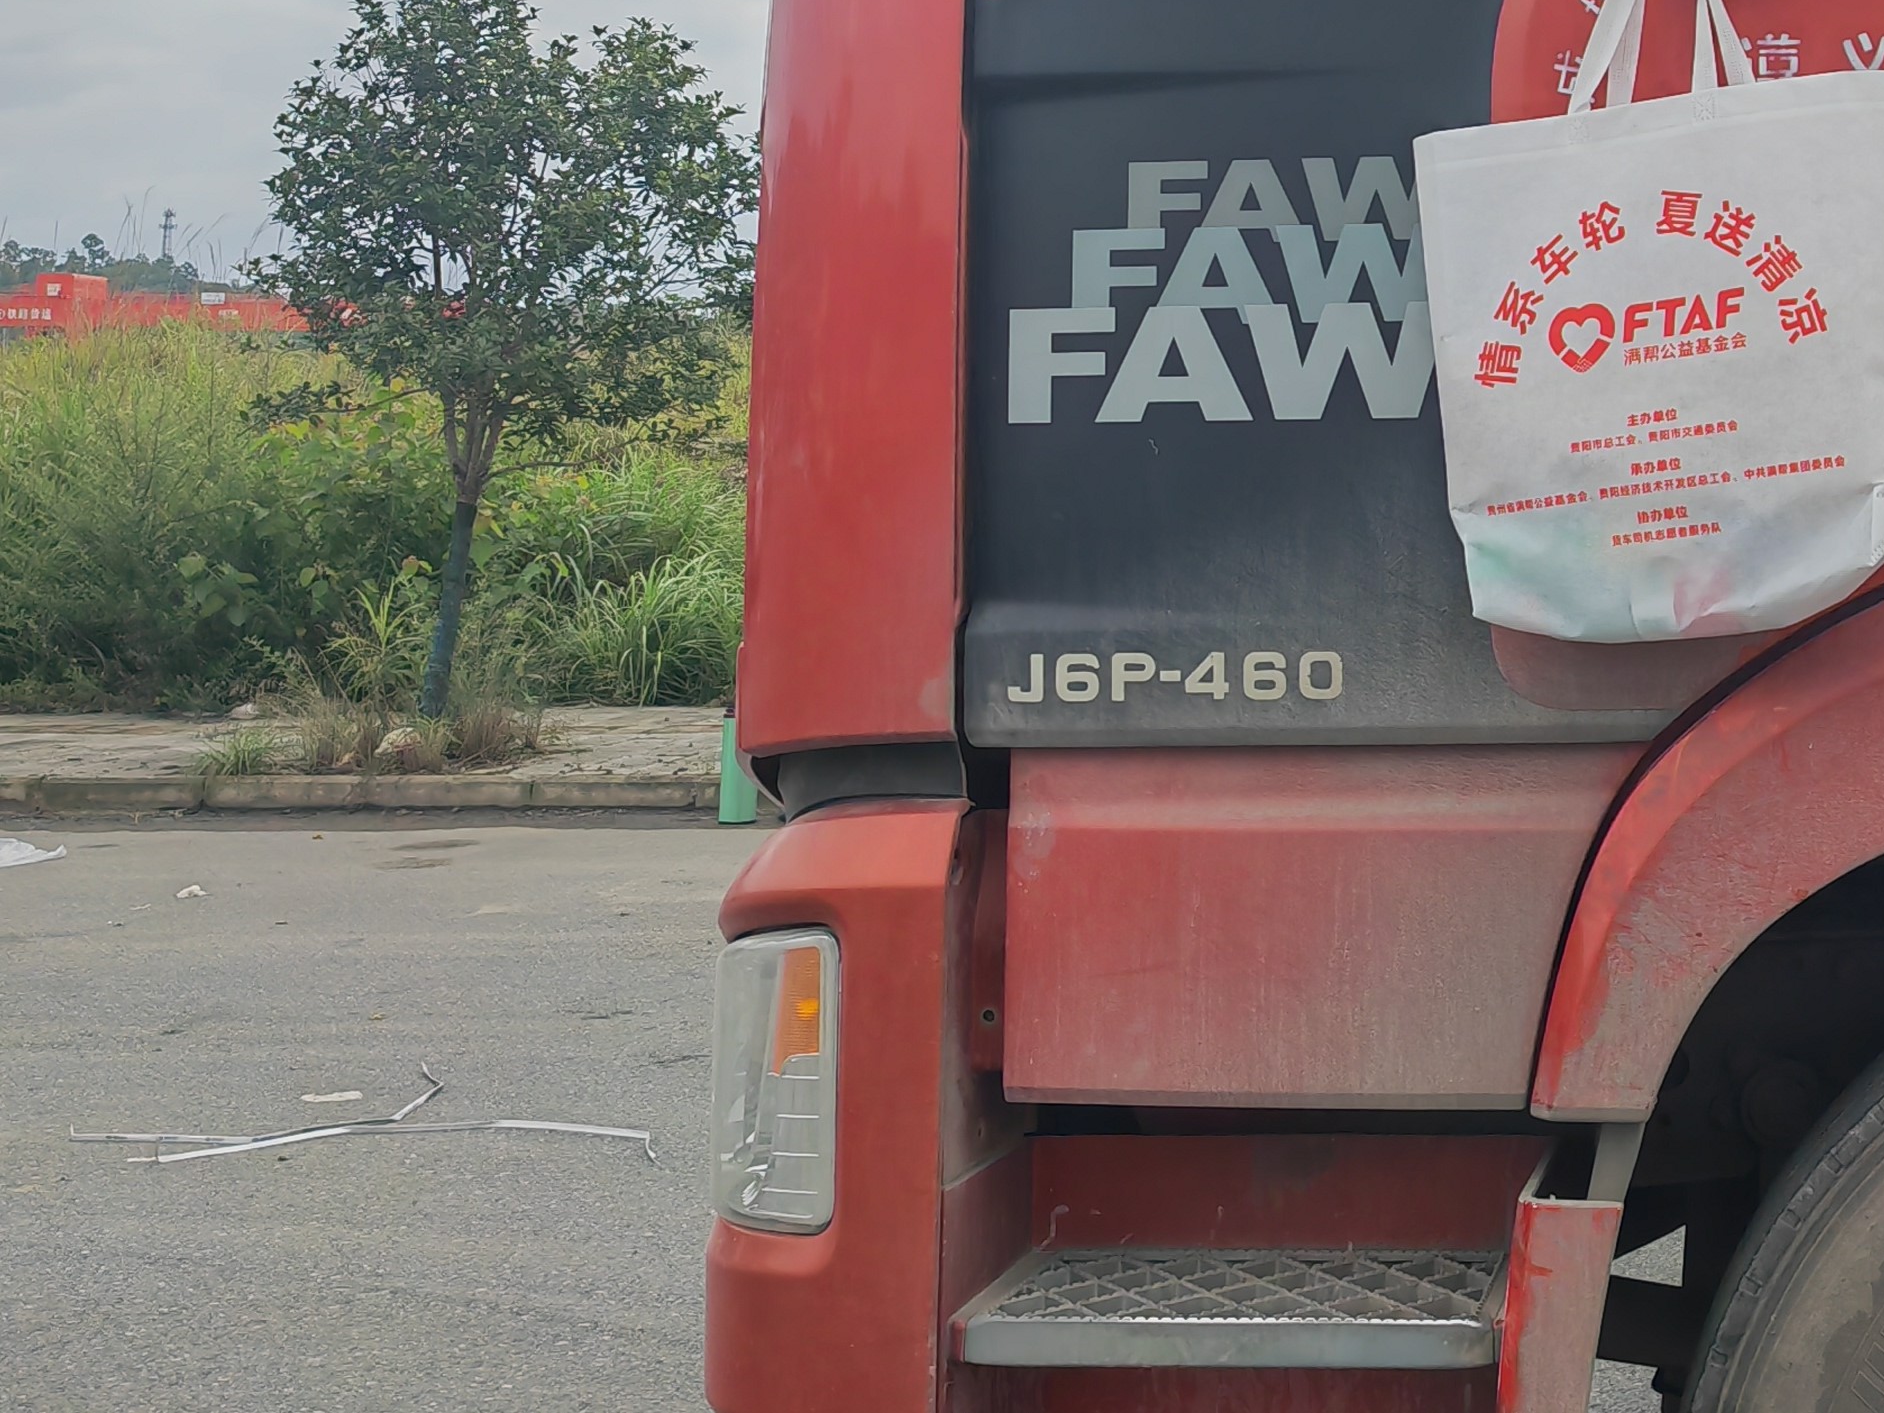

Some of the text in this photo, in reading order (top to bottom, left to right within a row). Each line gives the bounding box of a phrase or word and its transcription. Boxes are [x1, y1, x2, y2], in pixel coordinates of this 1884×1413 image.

[1127, 156, 1418, 242] FAW
[1072, 223, 1427, 324] FAW
[1622, 287, 1745, 343] FTAF
[1008, 302, 1438, 424] FAW
[1623, 332, 1747, 366] 满帮公益基金会
[1627, 408, 1678, 427] 主办单位
[1630, 458, 1681, 476] 承办单位
[1637, 506, 1689, 524] 协办单位
[1007, 651, 1343, 703] J6P-460
